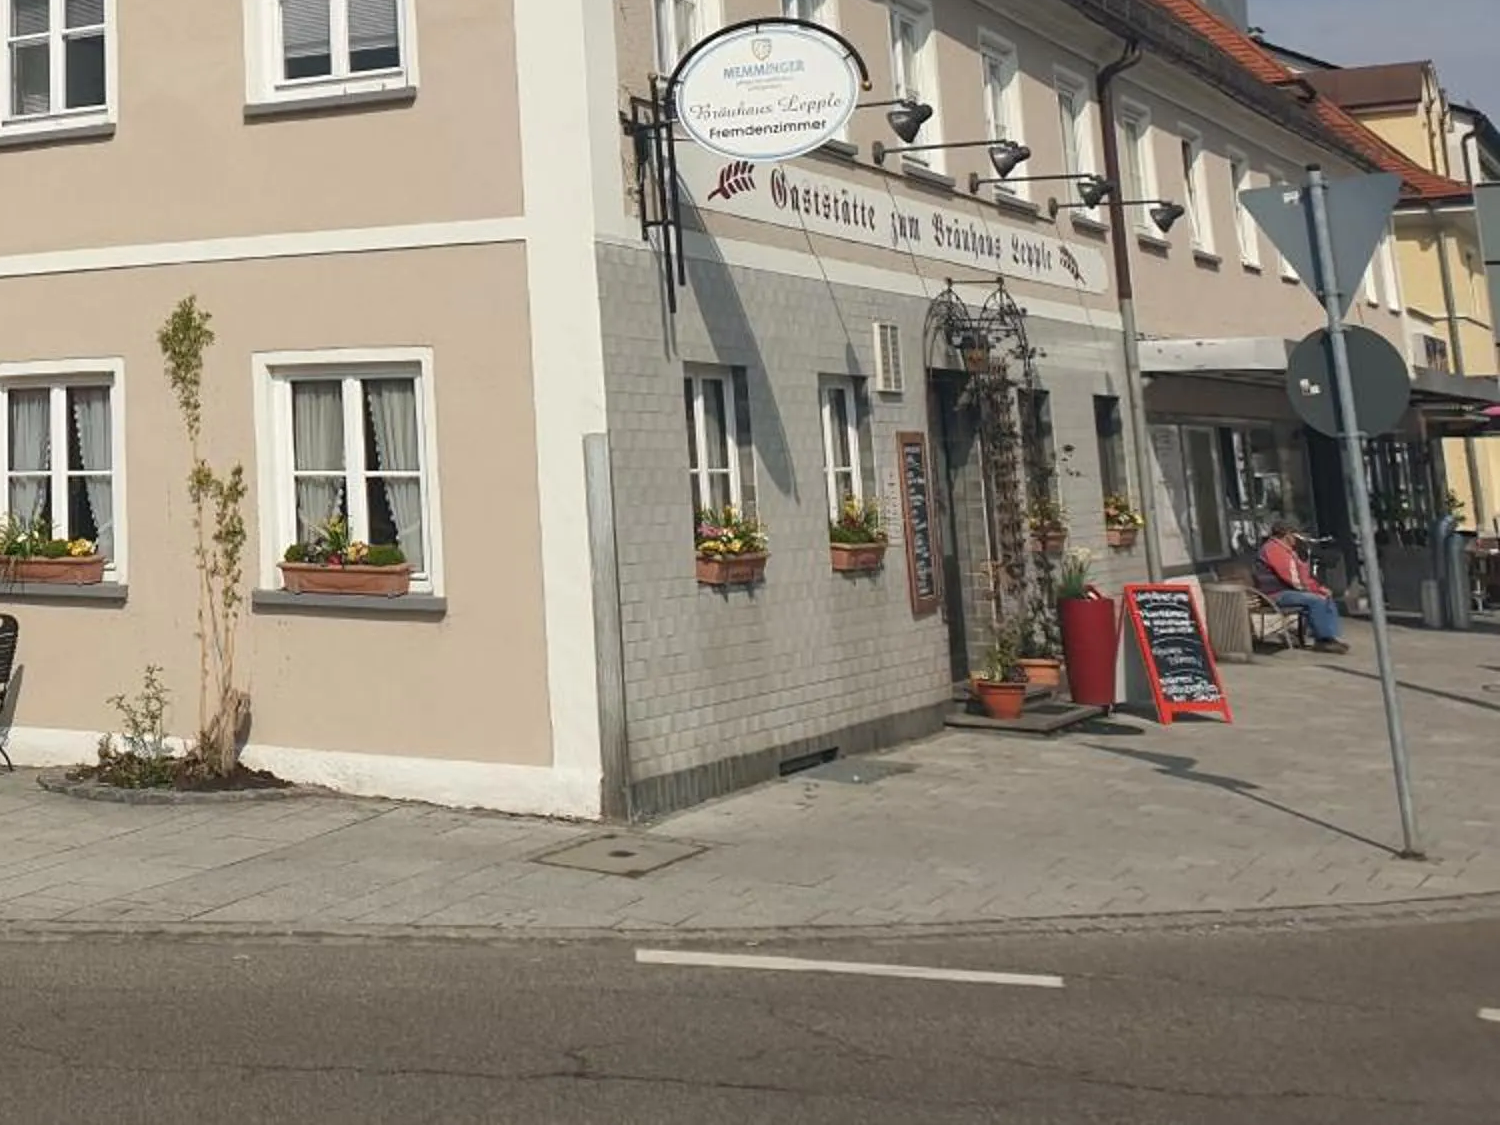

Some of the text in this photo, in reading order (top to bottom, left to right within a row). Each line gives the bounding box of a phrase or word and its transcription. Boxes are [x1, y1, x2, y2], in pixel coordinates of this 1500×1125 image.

[722, 60, 806, 80] MEMMINGER
[688, 91, 844, 121] Bräuhaus Lepple
[708, 118, 828, 140] Fremdenzimmer
[770, 165, 1053, 276] Gaststätte zum Bräuhaus Lepple
